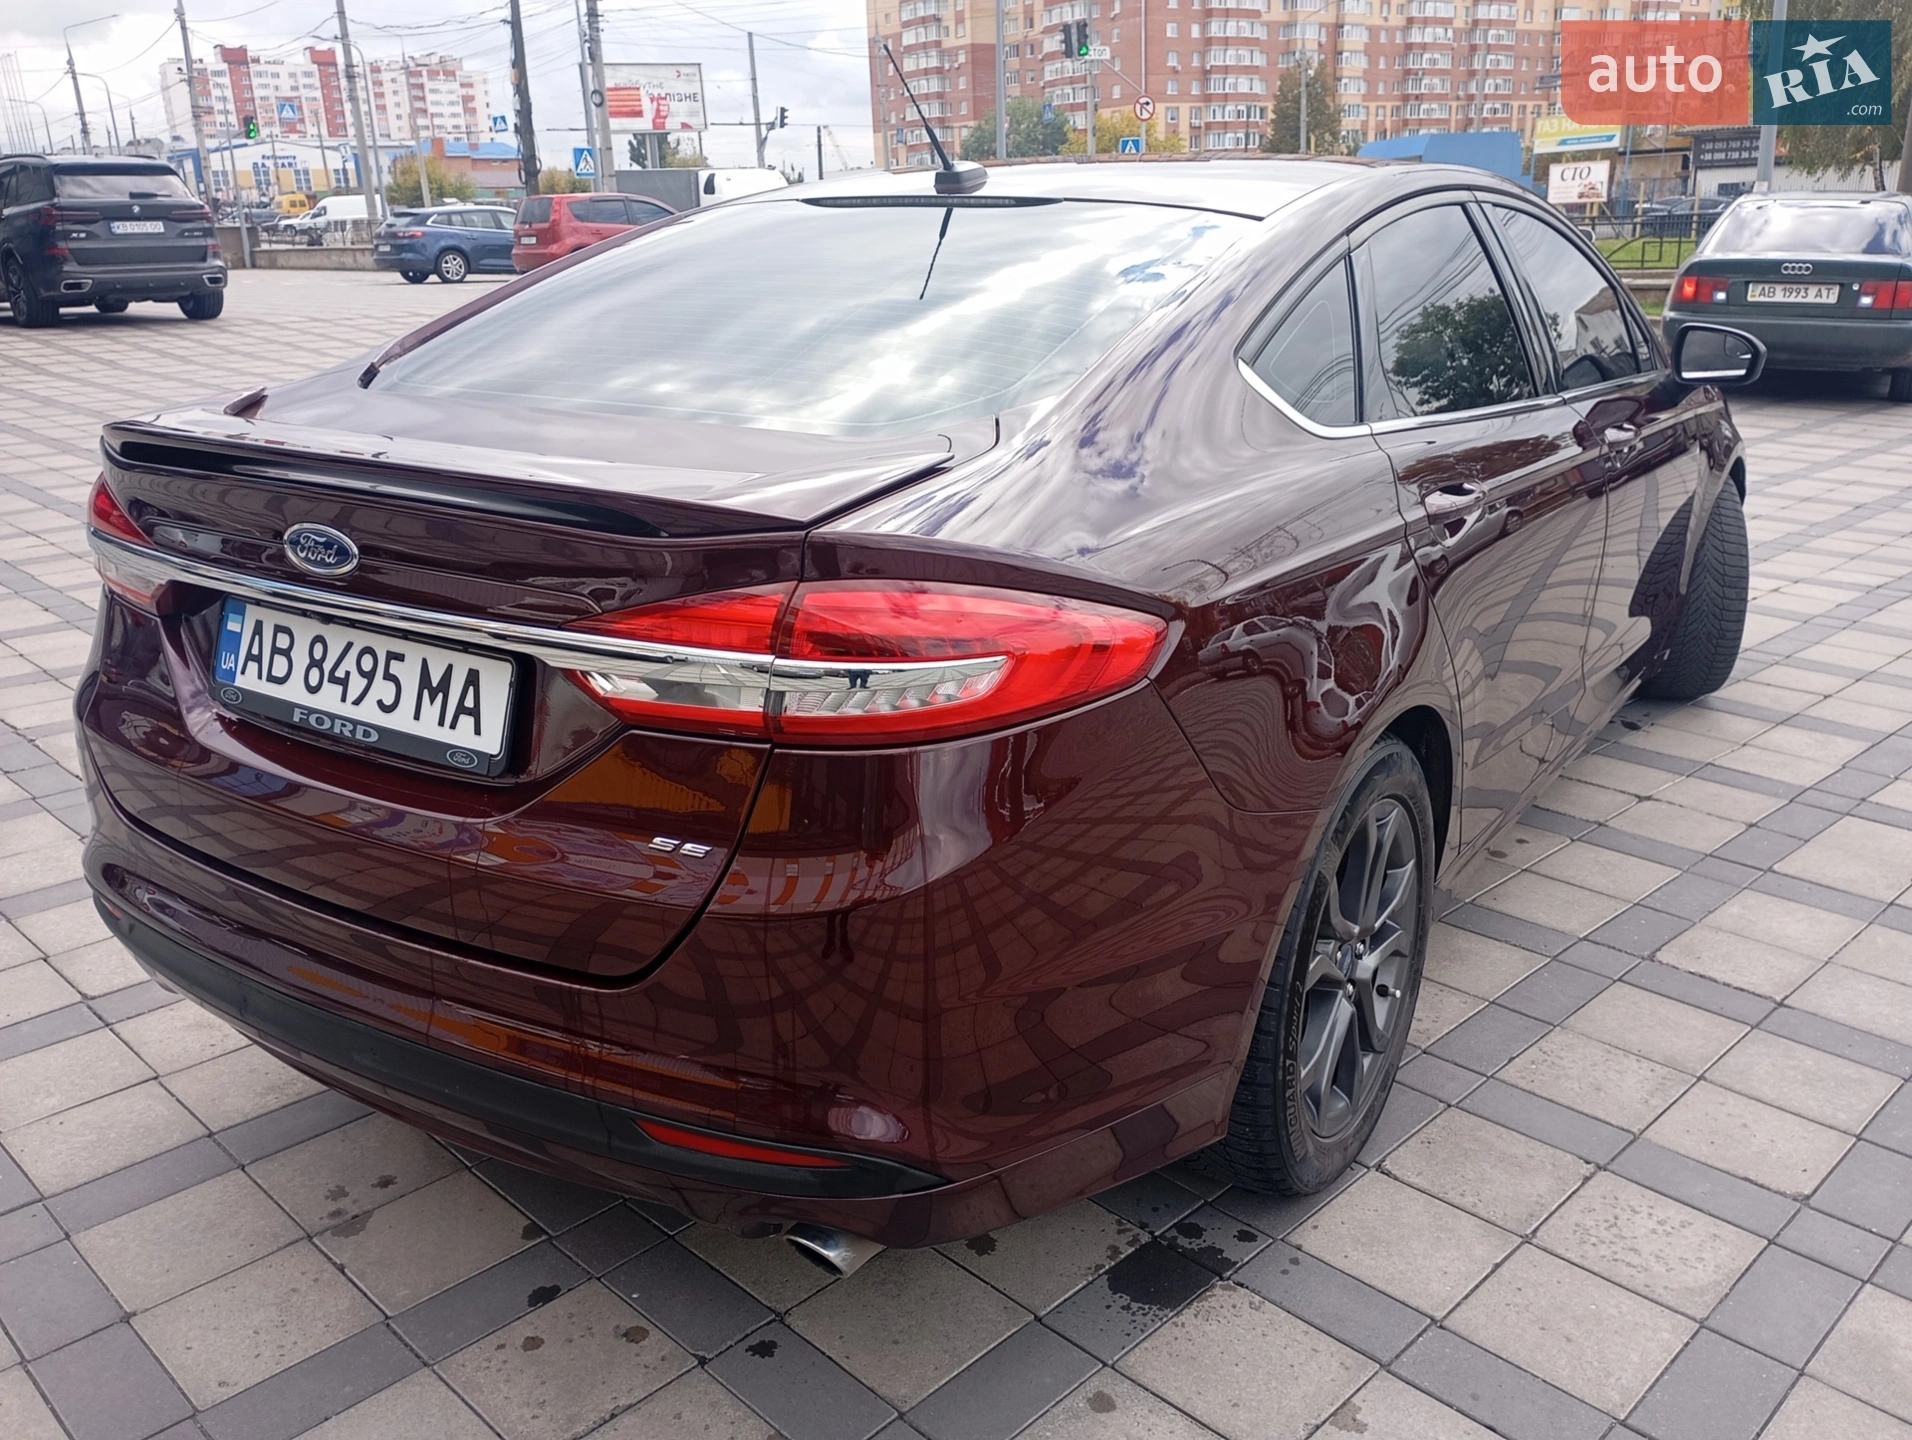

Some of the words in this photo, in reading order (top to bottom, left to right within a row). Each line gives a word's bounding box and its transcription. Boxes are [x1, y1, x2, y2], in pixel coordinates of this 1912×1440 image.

[1536, 119, 1559, 134] ГАЗ
[1560, 165, 1592, 182] СТО
[1758, 286, 1777, 299] AB
[1781, 286, 1810, 299] 1993
[1814, 287, 1834, 300] AT
[297, 532, 338, 564] Ford
[221, 651, 236, 672] UA
[240, 619, 295, 685] AB
[303, 634, 405, 714] 8495
[413, 657, 482, 736] MA
[292, 707, 380, 743] FORD
[648, 837, 713, 858] SE
